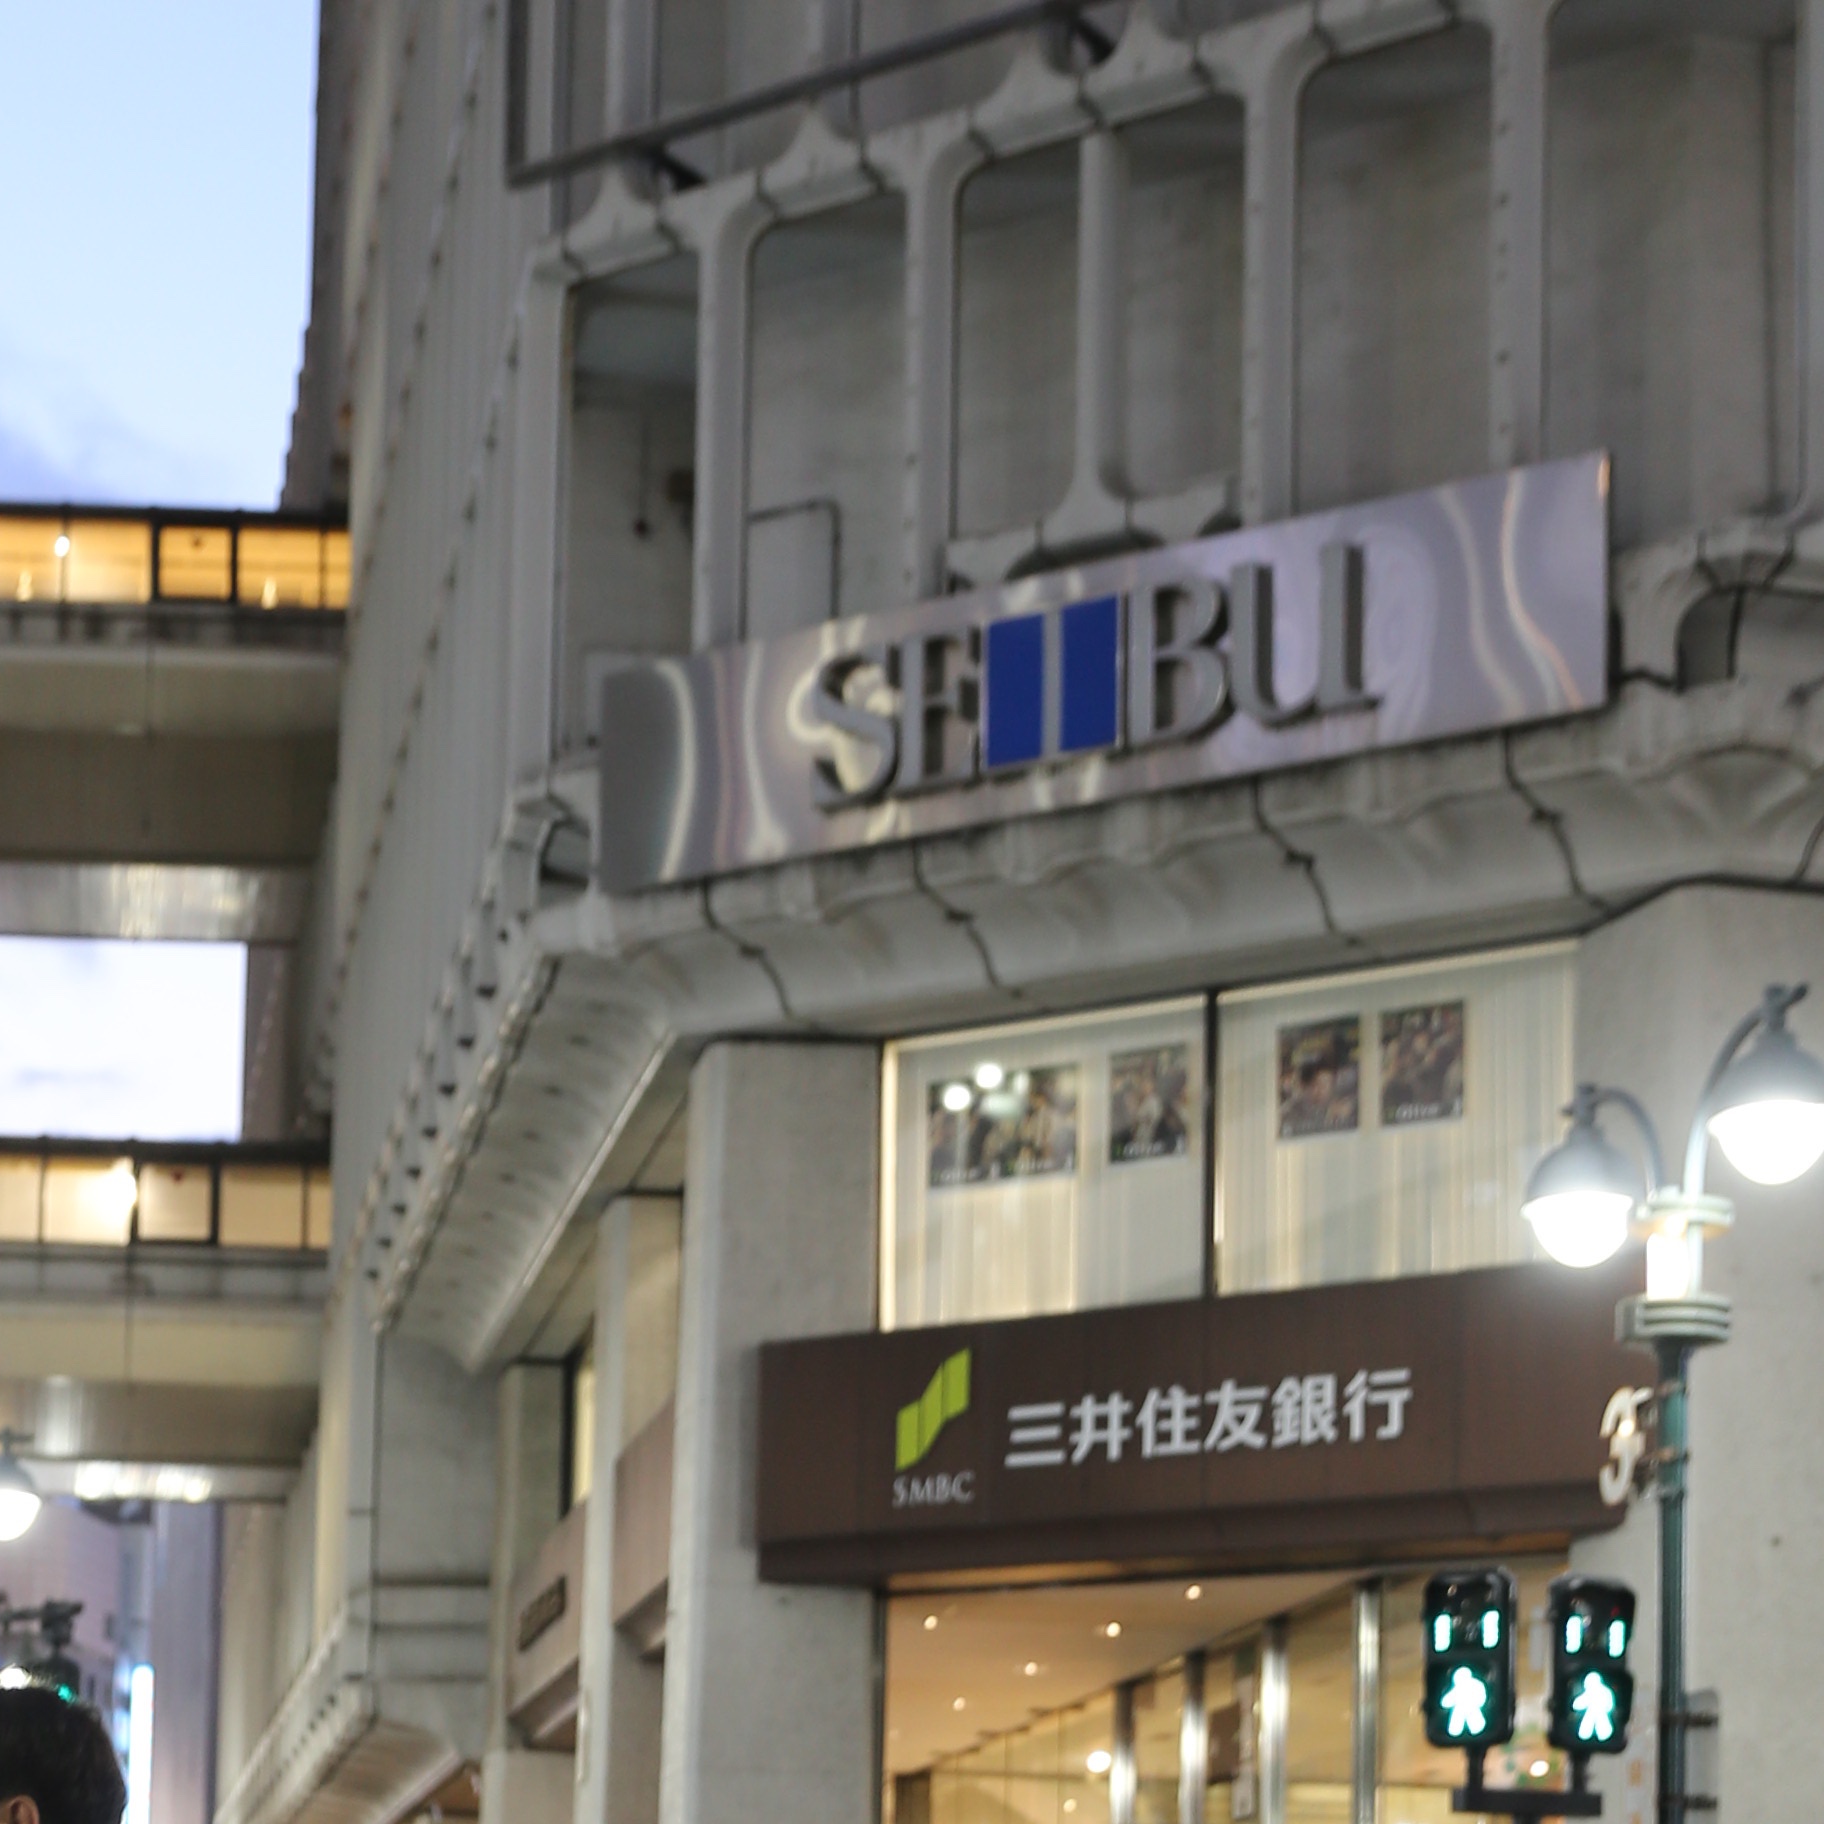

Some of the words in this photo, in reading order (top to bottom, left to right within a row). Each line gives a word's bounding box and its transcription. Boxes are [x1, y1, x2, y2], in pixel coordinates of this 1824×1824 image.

[812, 541, 1382, 811] SEIBU
[1004, 1367, 1413, 1469] 三井住友銀行
[892, 1469, 975, 1508] SMBC
